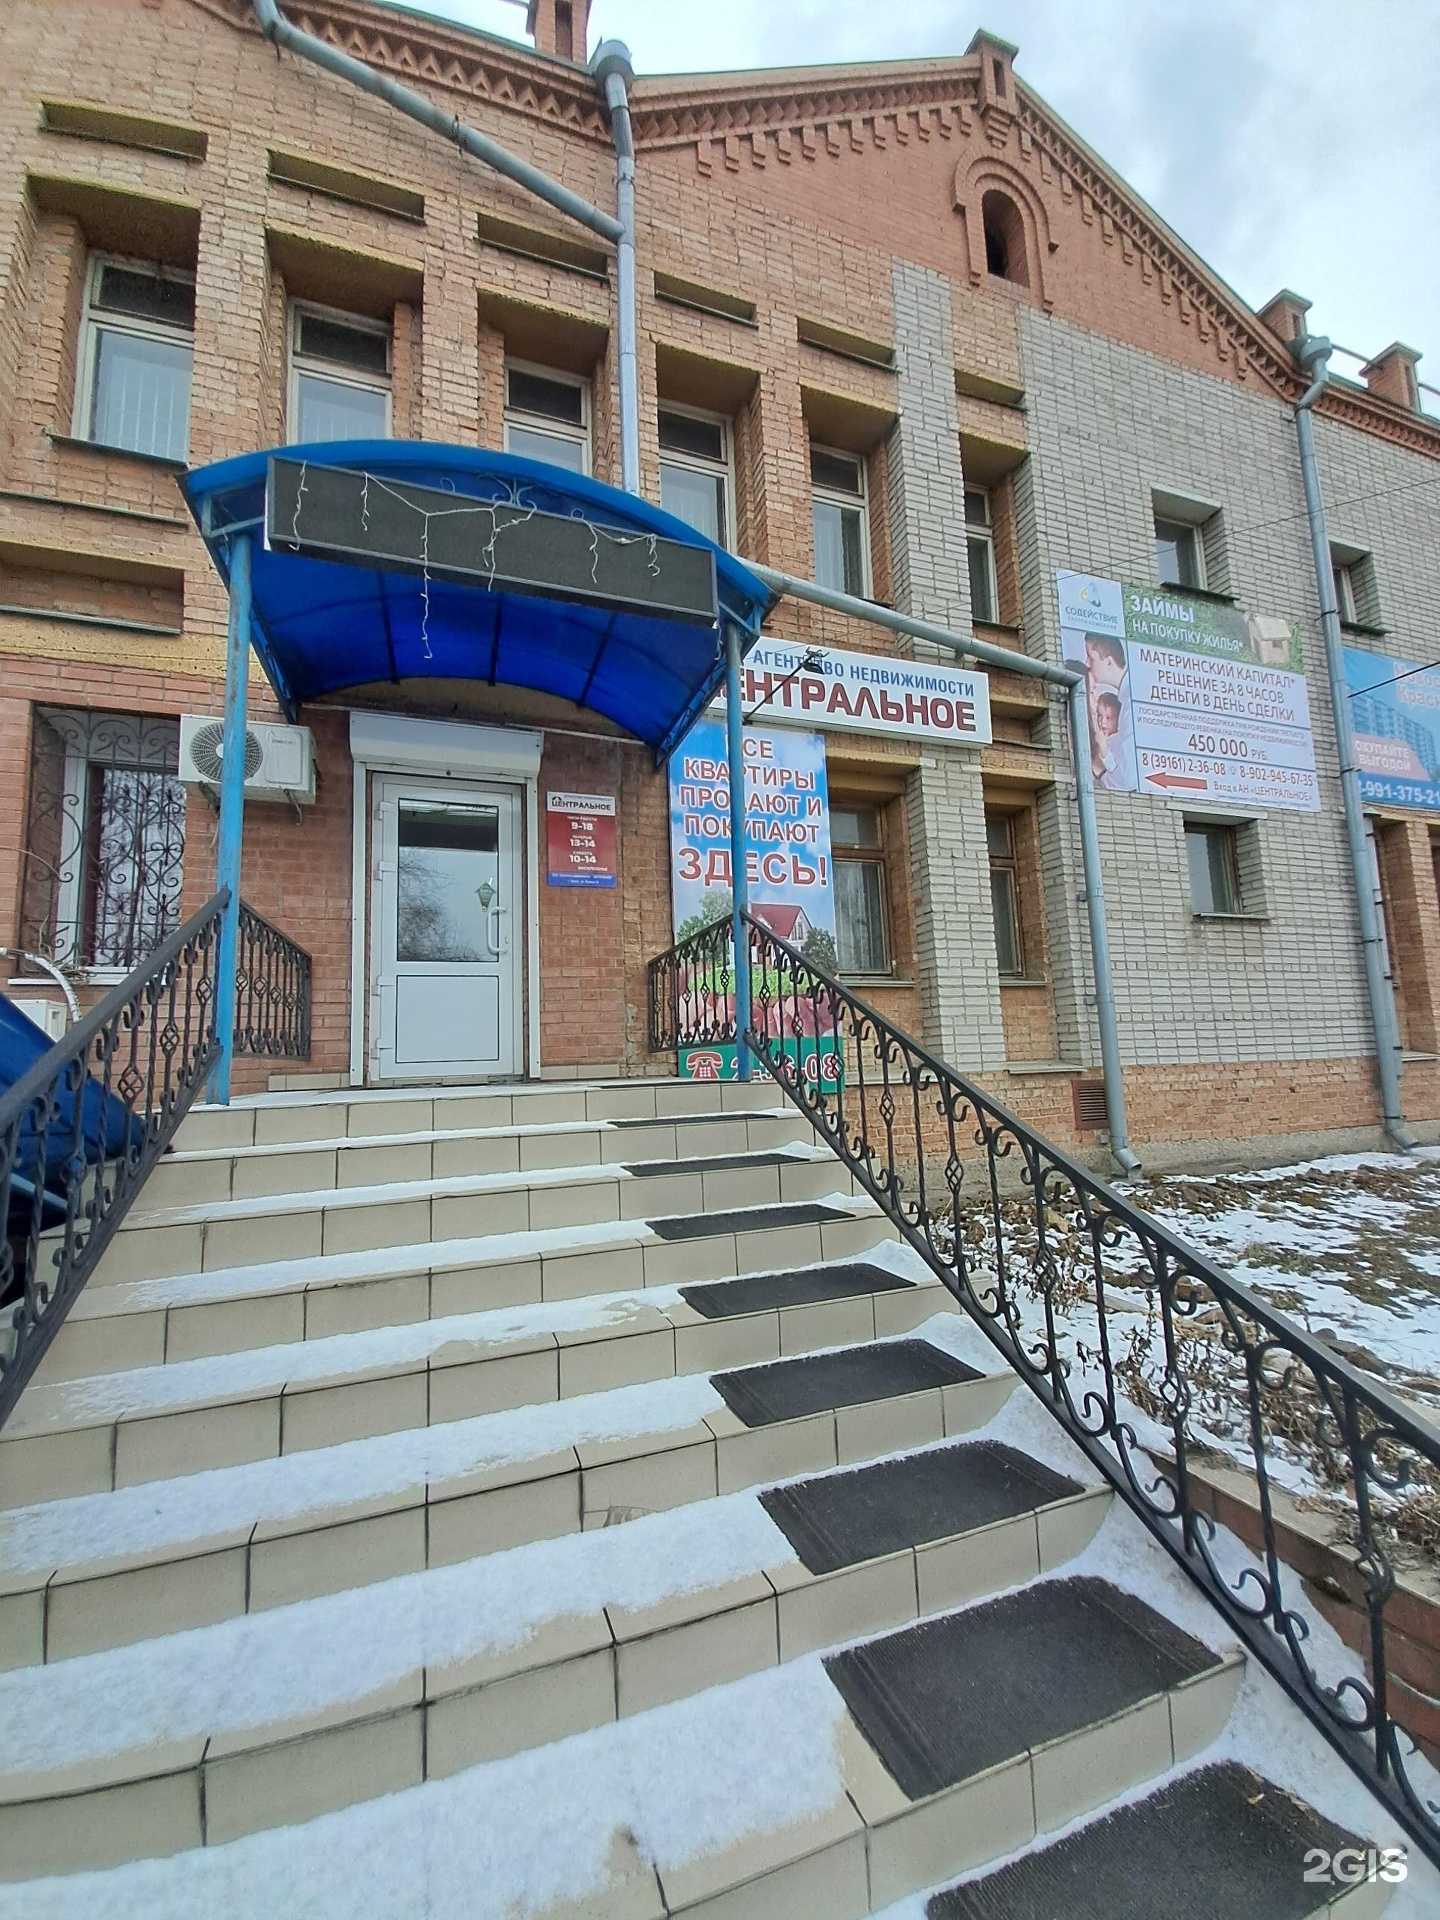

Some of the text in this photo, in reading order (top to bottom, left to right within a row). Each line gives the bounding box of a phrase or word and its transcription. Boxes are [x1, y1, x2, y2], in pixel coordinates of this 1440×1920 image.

[1065, 606, 1119, 624] СОДЕЙСТВИЕ
[1131, 595, 1194, 623] ЗАЙМЫ
[1132, 618, 1149, 634] НА
[1150, 621, 1200, 644] ПОКУПКУ
[754, 650, 974, 697] АГЕНТВО НЕДВИЖИМОСТИ
[1140, 648, 1234, 678] МАТЕРИНСКИЙ
[715, 667, 977, 732] НТРАЛЬНОЕ
[1158, 669, 1219, 693] РЕШЕНИЕ
[1220, 680, 1235, 697] ЗА
[1246, 685, 1285, 704] ЧАСОВ
[1151, 685, 1295, 721] ДЕНЬГИ В ДЕНЬ СДЕЛКИ
[743, 738, 774, 760] СЕ
[1188, 733, 1216, 753] 450
[1220, 738, 1248, 758] 000
[685, 759, 814, 790] КВАТИРЫ
[1142, 752, 1149, 766] 8
[1151, 753, 1185, 773] (39161)
[1188, 758, 1226, 776] 2-36-08
[552, 799, 611, 811] ЦЕНТРАЛЬНОЕ
[680, 786, 821, 817] ПРОАЮТ И
[571, 821, 593, 831] 9-18
